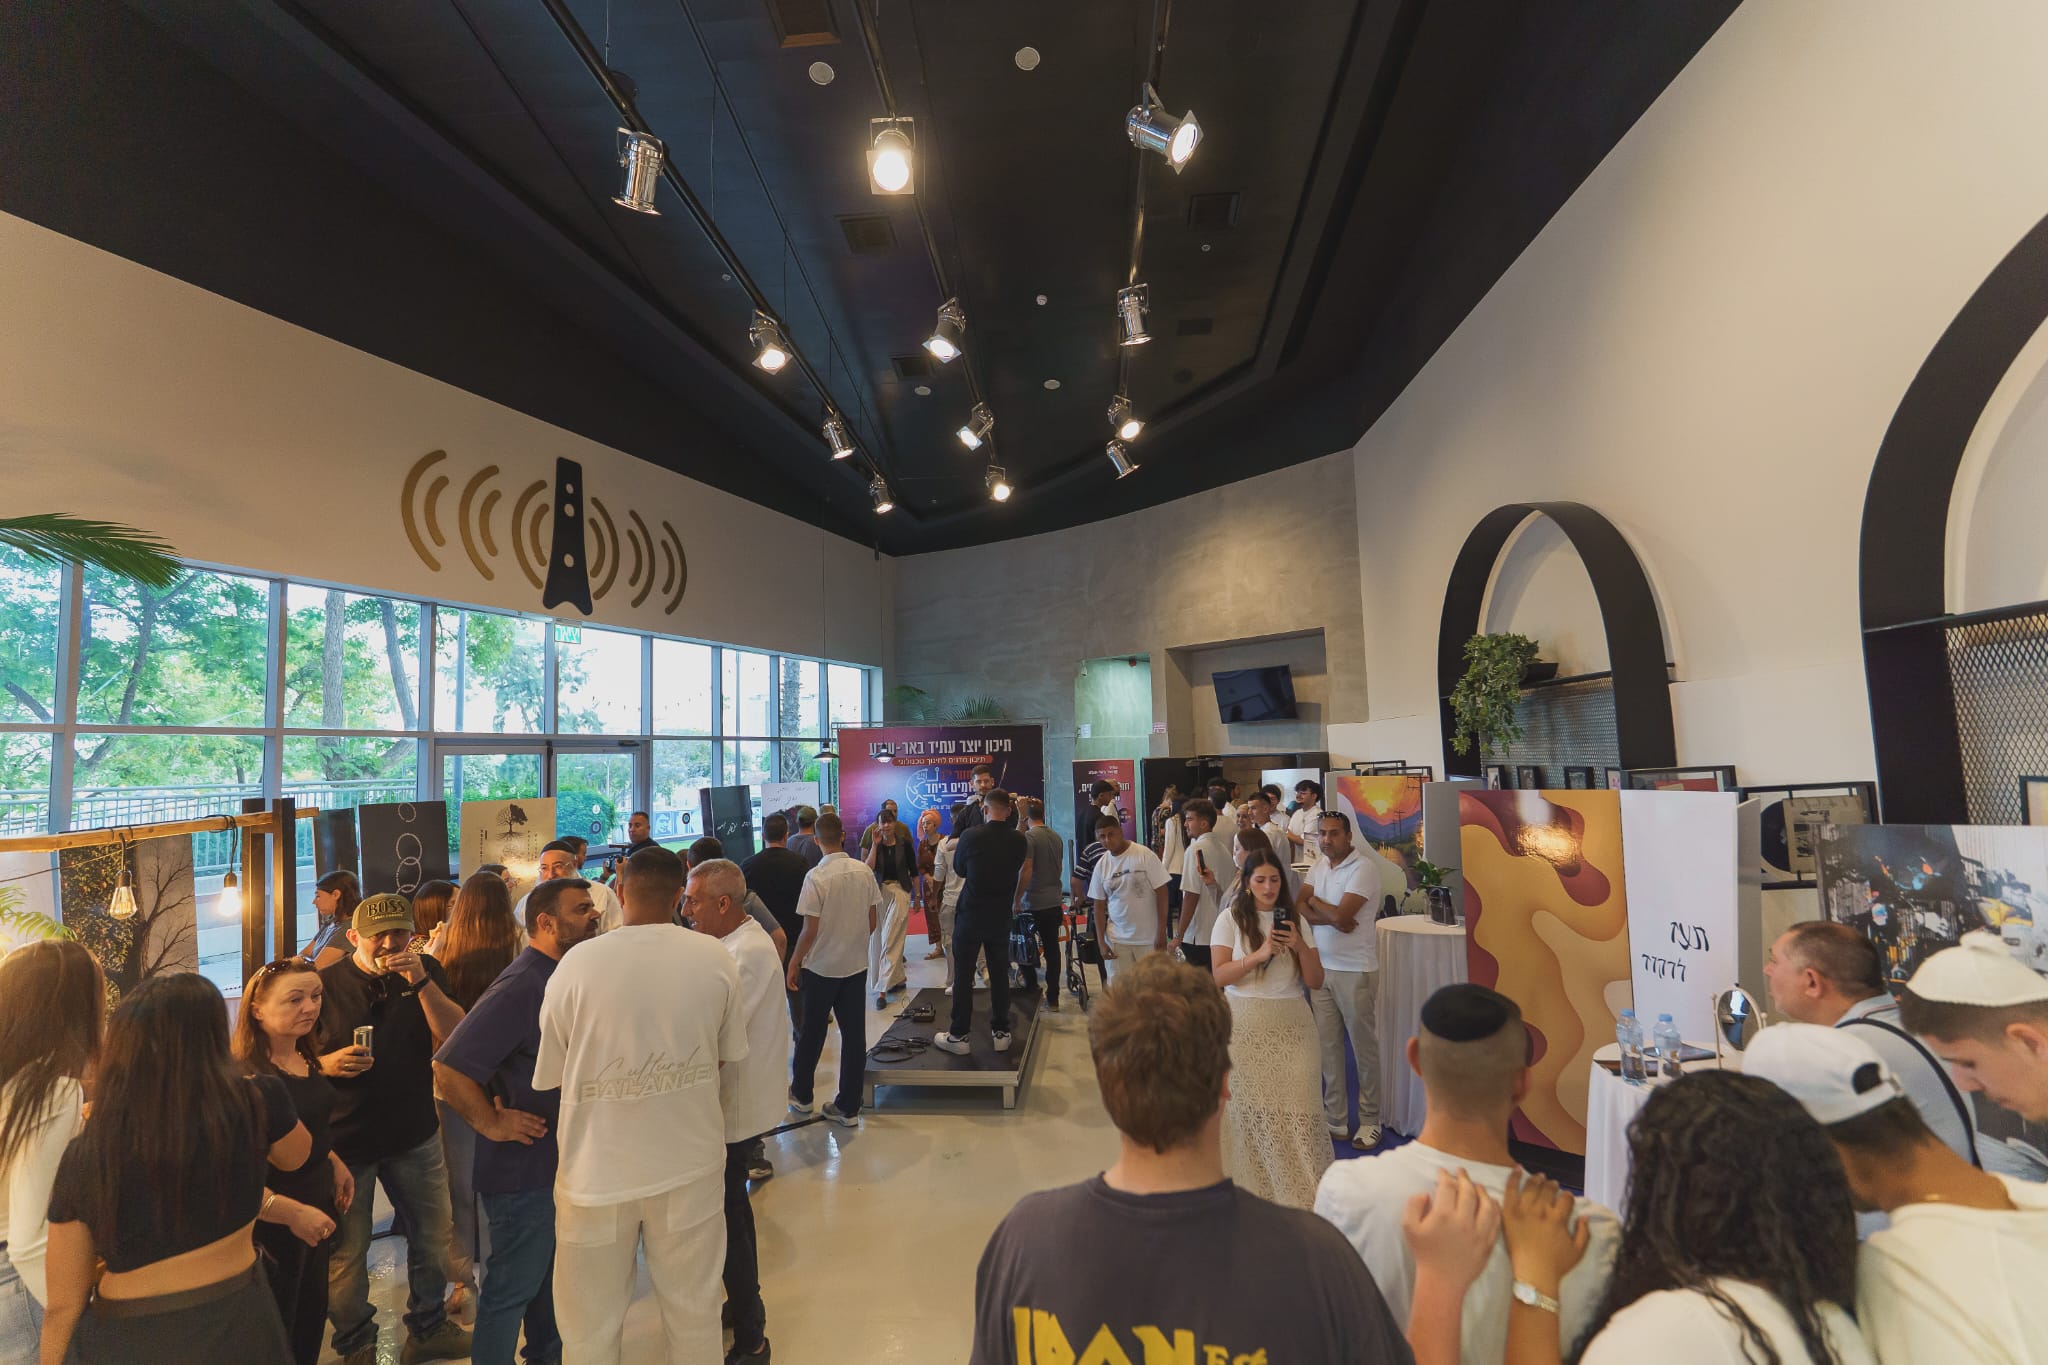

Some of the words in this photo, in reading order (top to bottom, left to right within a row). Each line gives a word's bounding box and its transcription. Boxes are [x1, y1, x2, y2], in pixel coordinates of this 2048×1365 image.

[928, 740, 956, 754] עתיד
[960, 739, 982, 753] יוצר
[985, 738, 1012, 754] תיכון
[926, 756, 947, 766] לחינוך
[969, 756, 986, 764] תיכון
[925, 782, 948, 794] ביחד
[366, 898, 406, 917] BOSS
[1641, 953, 1686, 983] לרקוד
